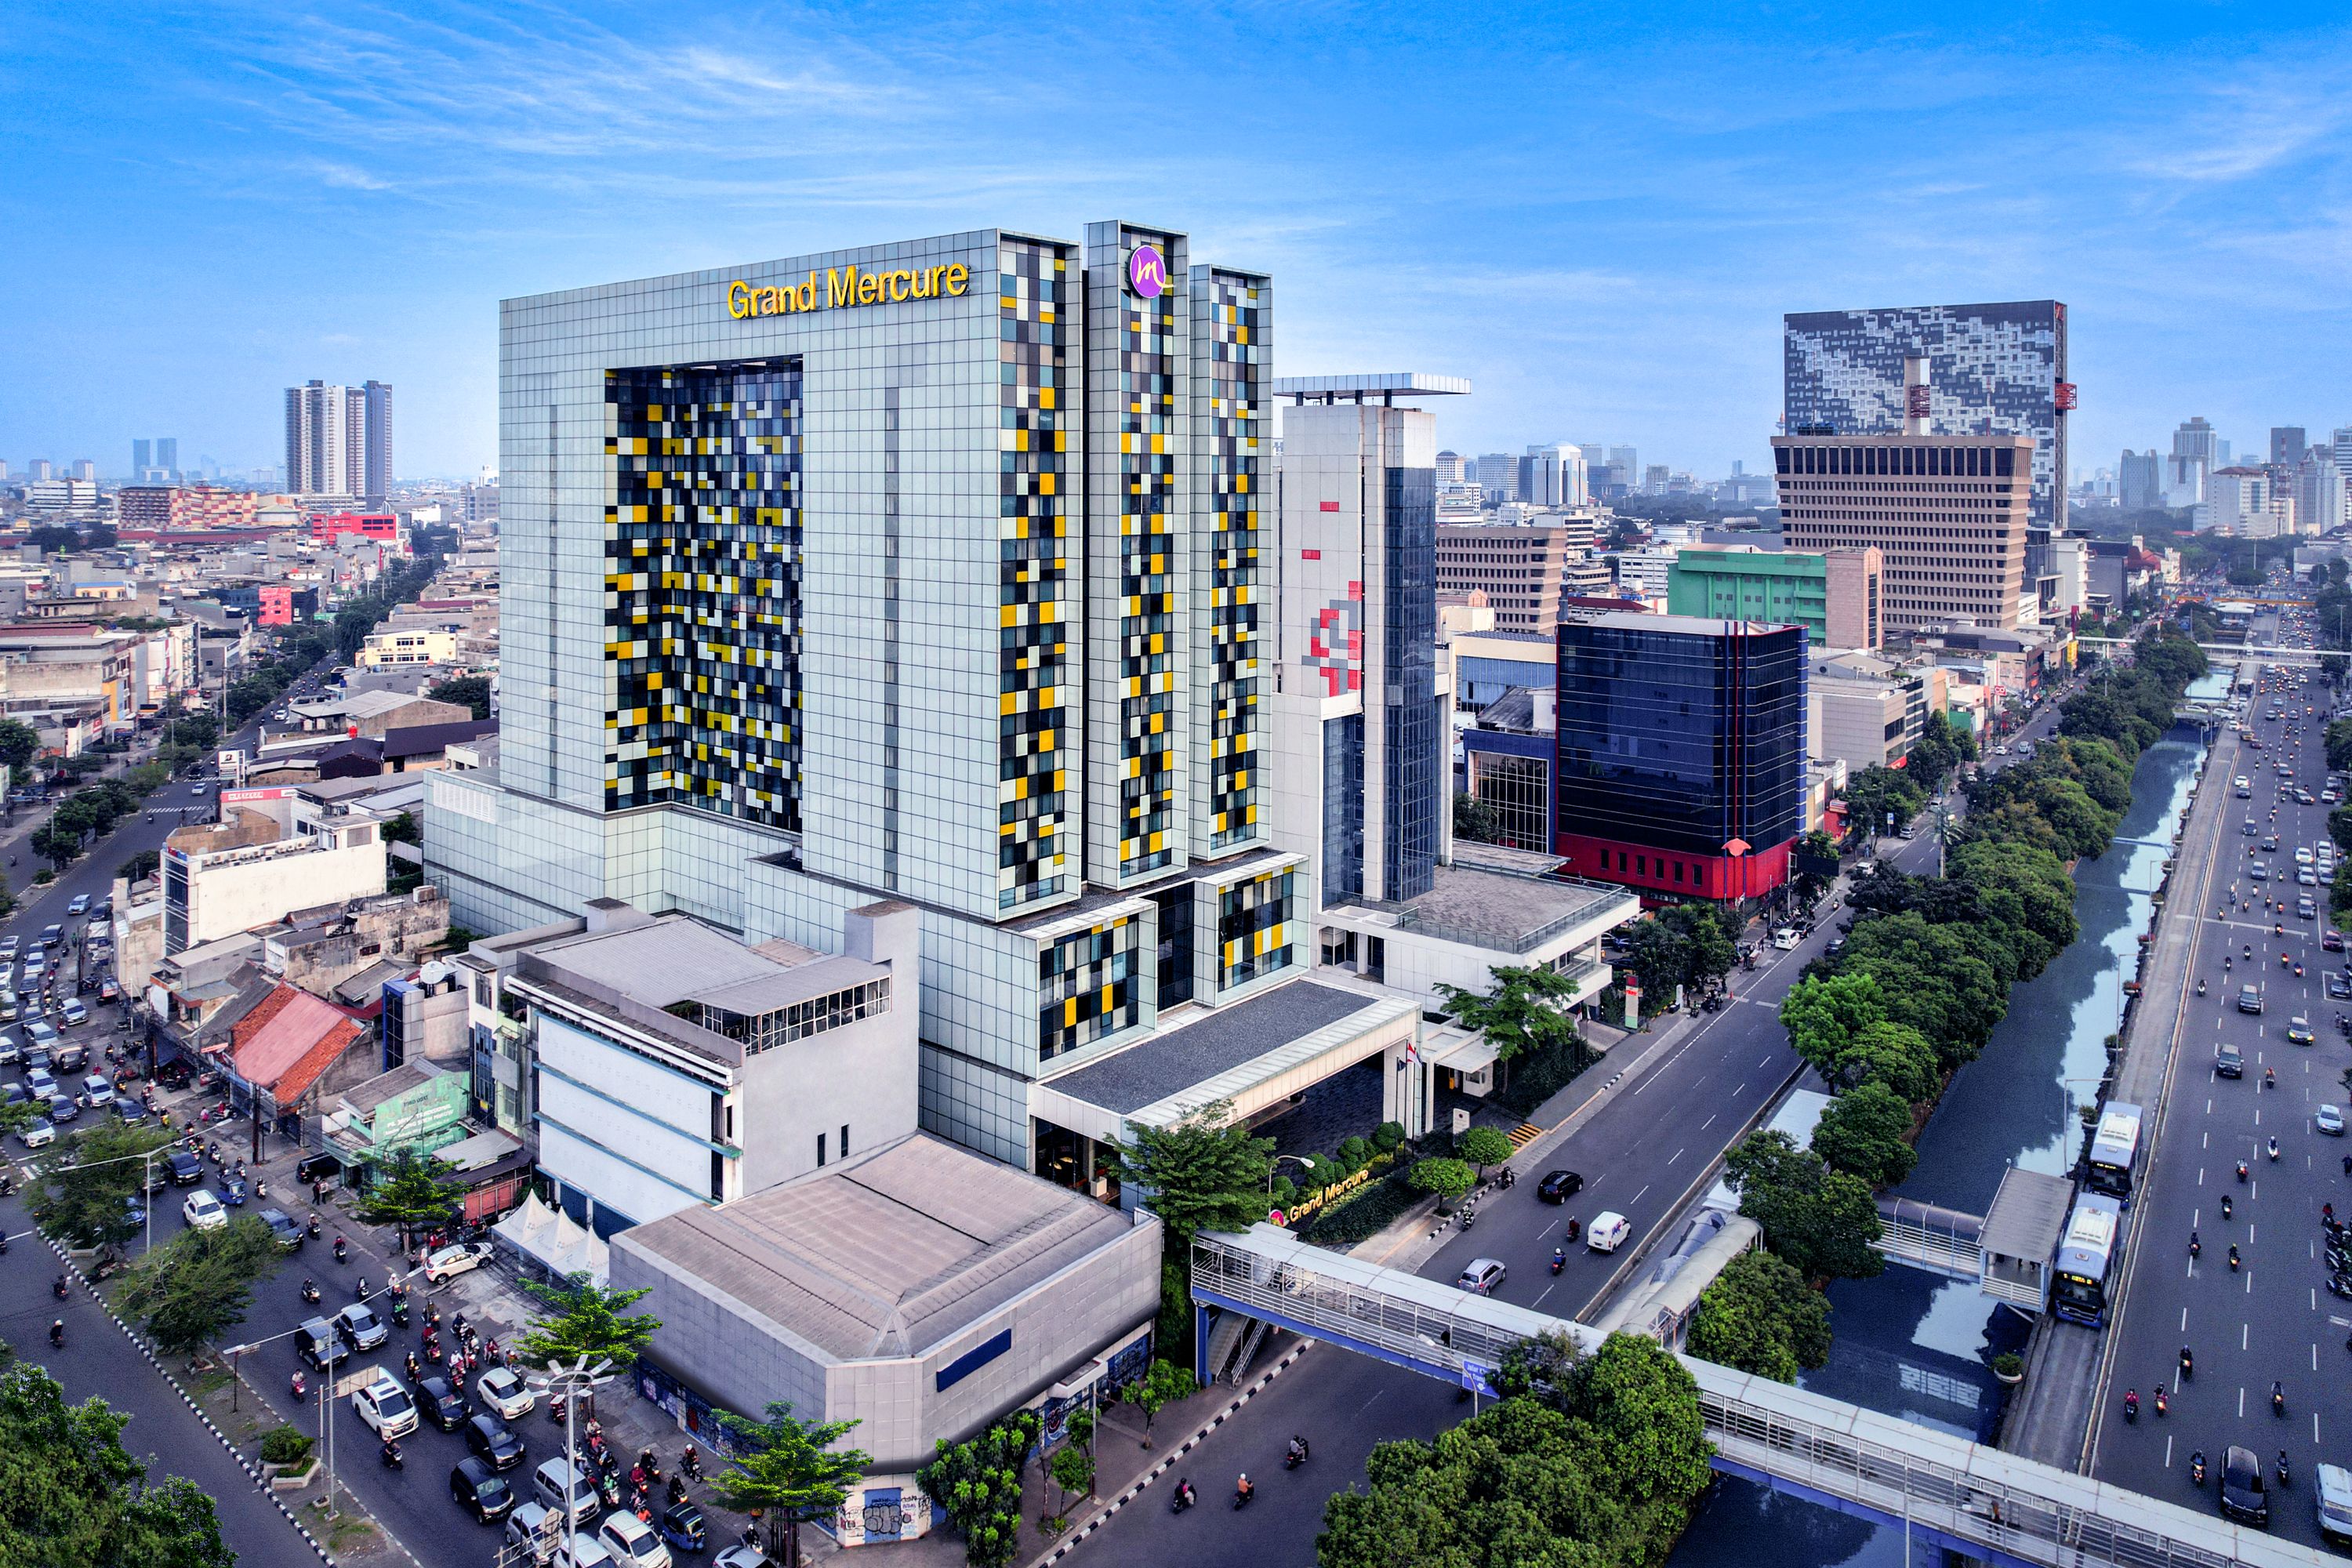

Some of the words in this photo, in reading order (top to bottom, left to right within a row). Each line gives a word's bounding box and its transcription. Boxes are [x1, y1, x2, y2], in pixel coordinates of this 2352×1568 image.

[728, 270, 816, 319] Grand
[827, 263, 969, 308] Mercure
[1290, 1190, 1323, 1222] Grand
[1325, 1170, 1369, 1202] Mercure
